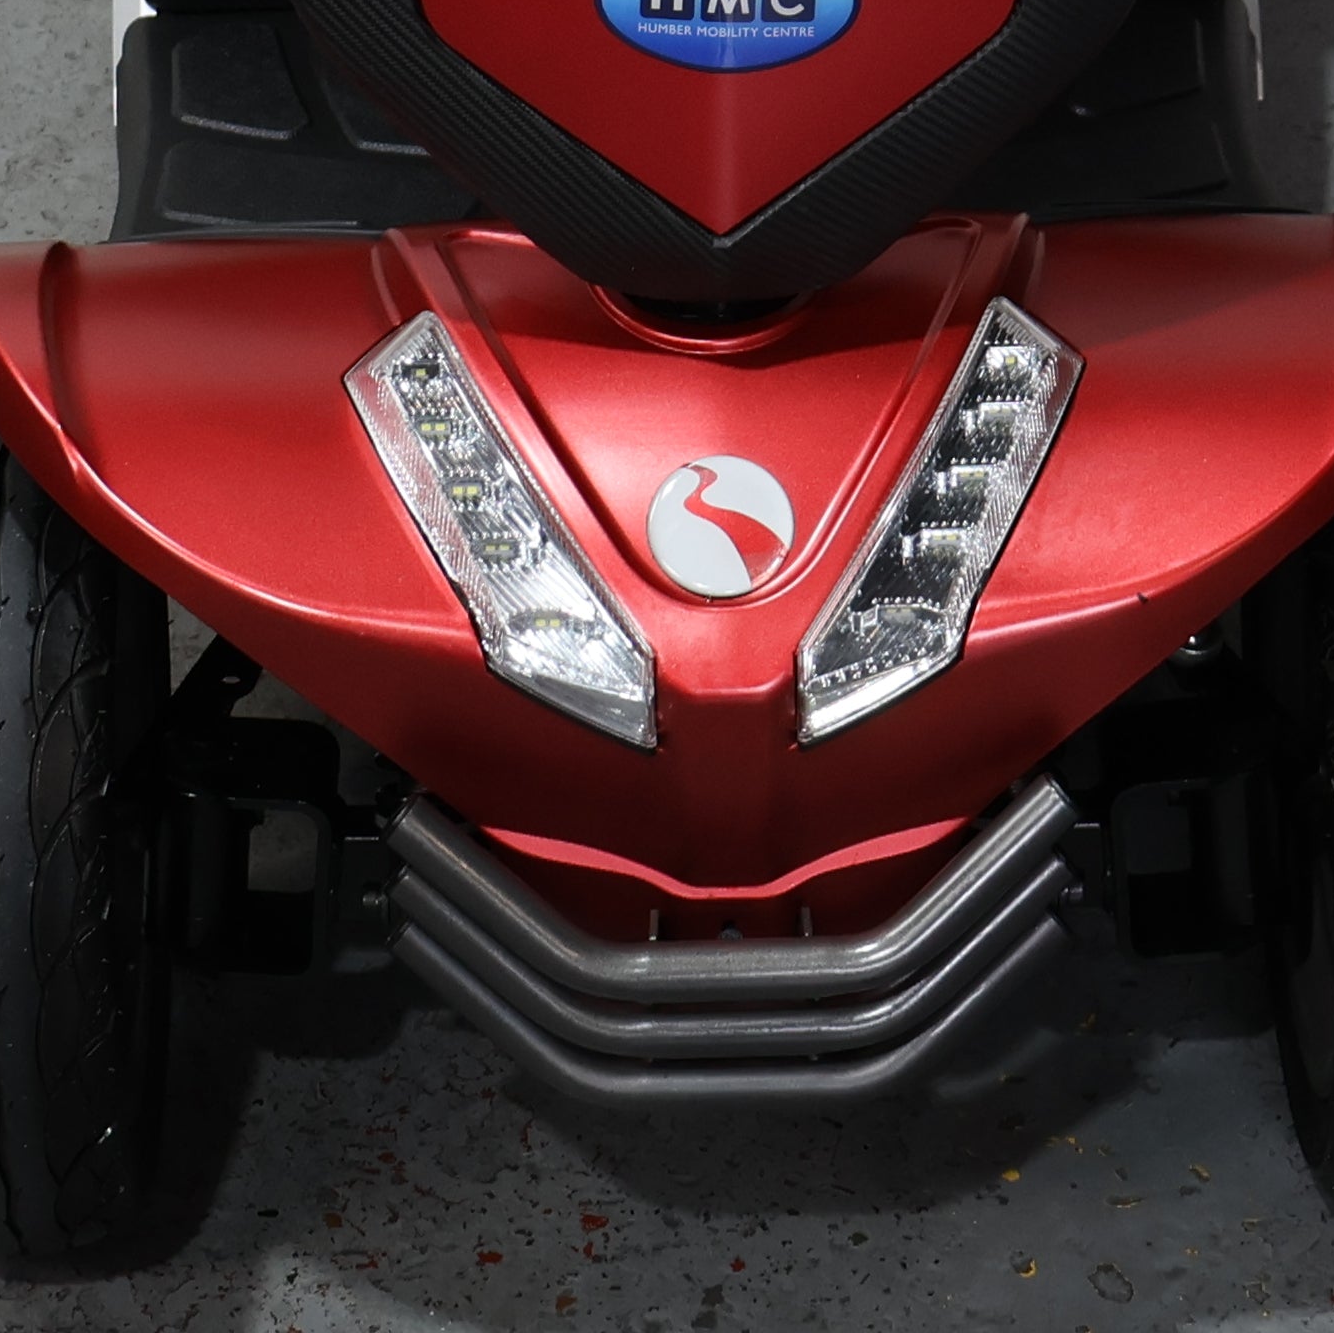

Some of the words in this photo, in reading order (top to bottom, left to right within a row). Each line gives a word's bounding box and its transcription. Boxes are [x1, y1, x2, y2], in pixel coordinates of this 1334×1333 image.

[638, 22, 692, 36] HUMBER
[696, 26, 758, 38] MOBILITY
[763, 27, 815, 37] CENTRE
